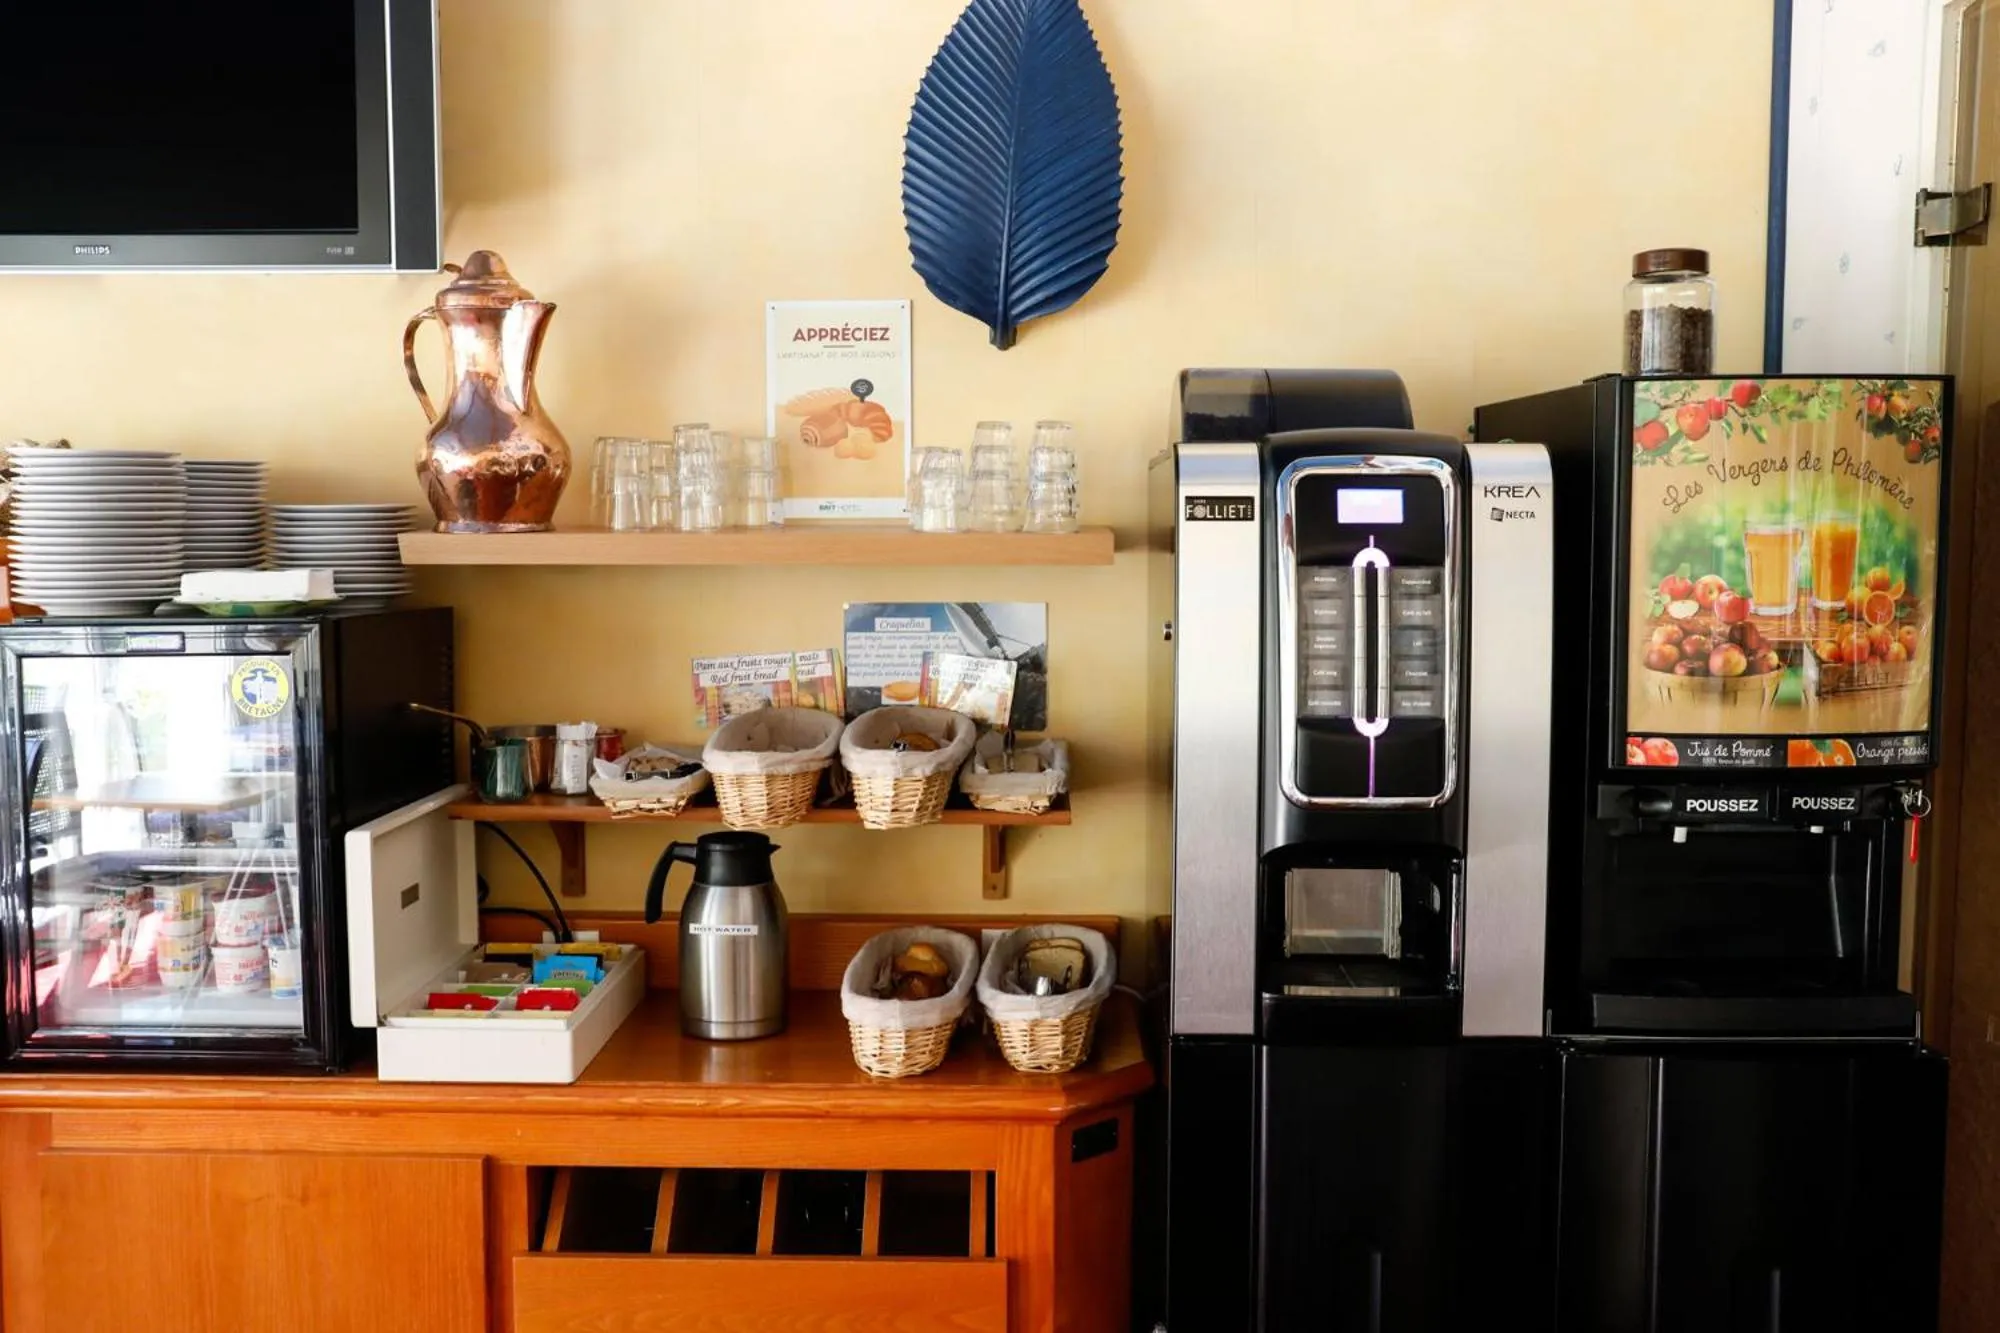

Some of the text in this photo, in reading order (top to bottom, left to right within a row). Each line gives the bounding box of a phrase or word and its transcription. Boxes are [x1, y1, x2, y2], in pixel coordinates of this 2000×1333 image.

[75, 246, 111, 255] PHILIPS
[792, 322, 890, 342] APPRÉCIEZ
[1662, 447, 1916, 514] Les Vergers de Philomène
[1483, 485, 1541, 499] KREA
[1186, 504, 1247, 519] FOLLIET
[1505, 511, 1536, 519] NECTA
[694, 655, 792, 671] Pain aux fruits rouges
[710, 669, 779, 685] Red fruit bread
[1687, 741, 1710, 757] Jus
[1714, 744, 1729, 757] de
[1856, 742, 1895, 765] Orange
[1686, 799, 1759, 813] POUSSEZ
[1792, 796, 1856, 811] POUSSEZ
